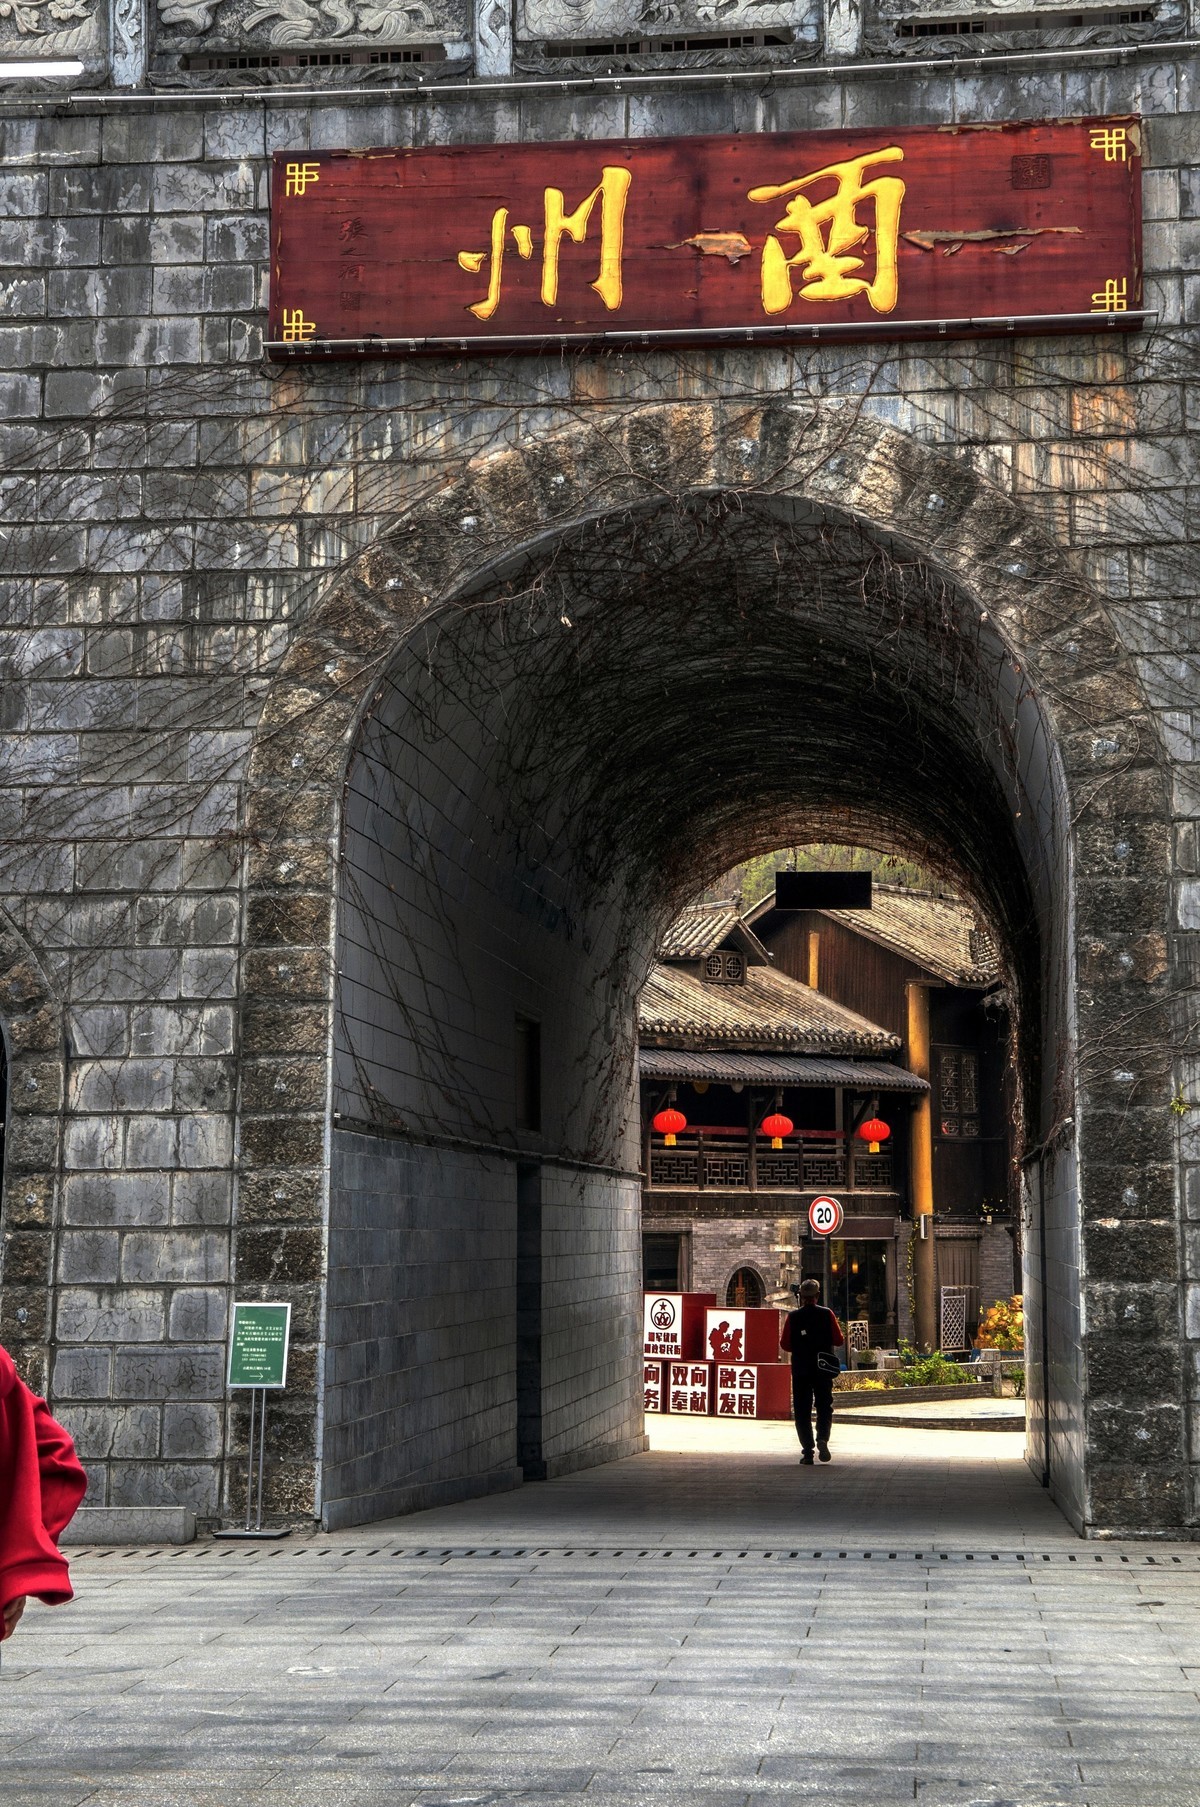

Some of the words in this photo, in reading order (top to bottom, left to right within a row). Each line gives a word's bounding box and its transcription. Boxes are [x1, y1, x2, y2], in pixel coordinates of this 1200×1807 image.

[817, 1207, 832, 1224] 20
[672, 1365, 707, 1387] 双向
[719, 1367, 756, 1390] 融合
[671, 1390, 707, 1413] 奉献
[719, 1392, 756, 1416] 发展
